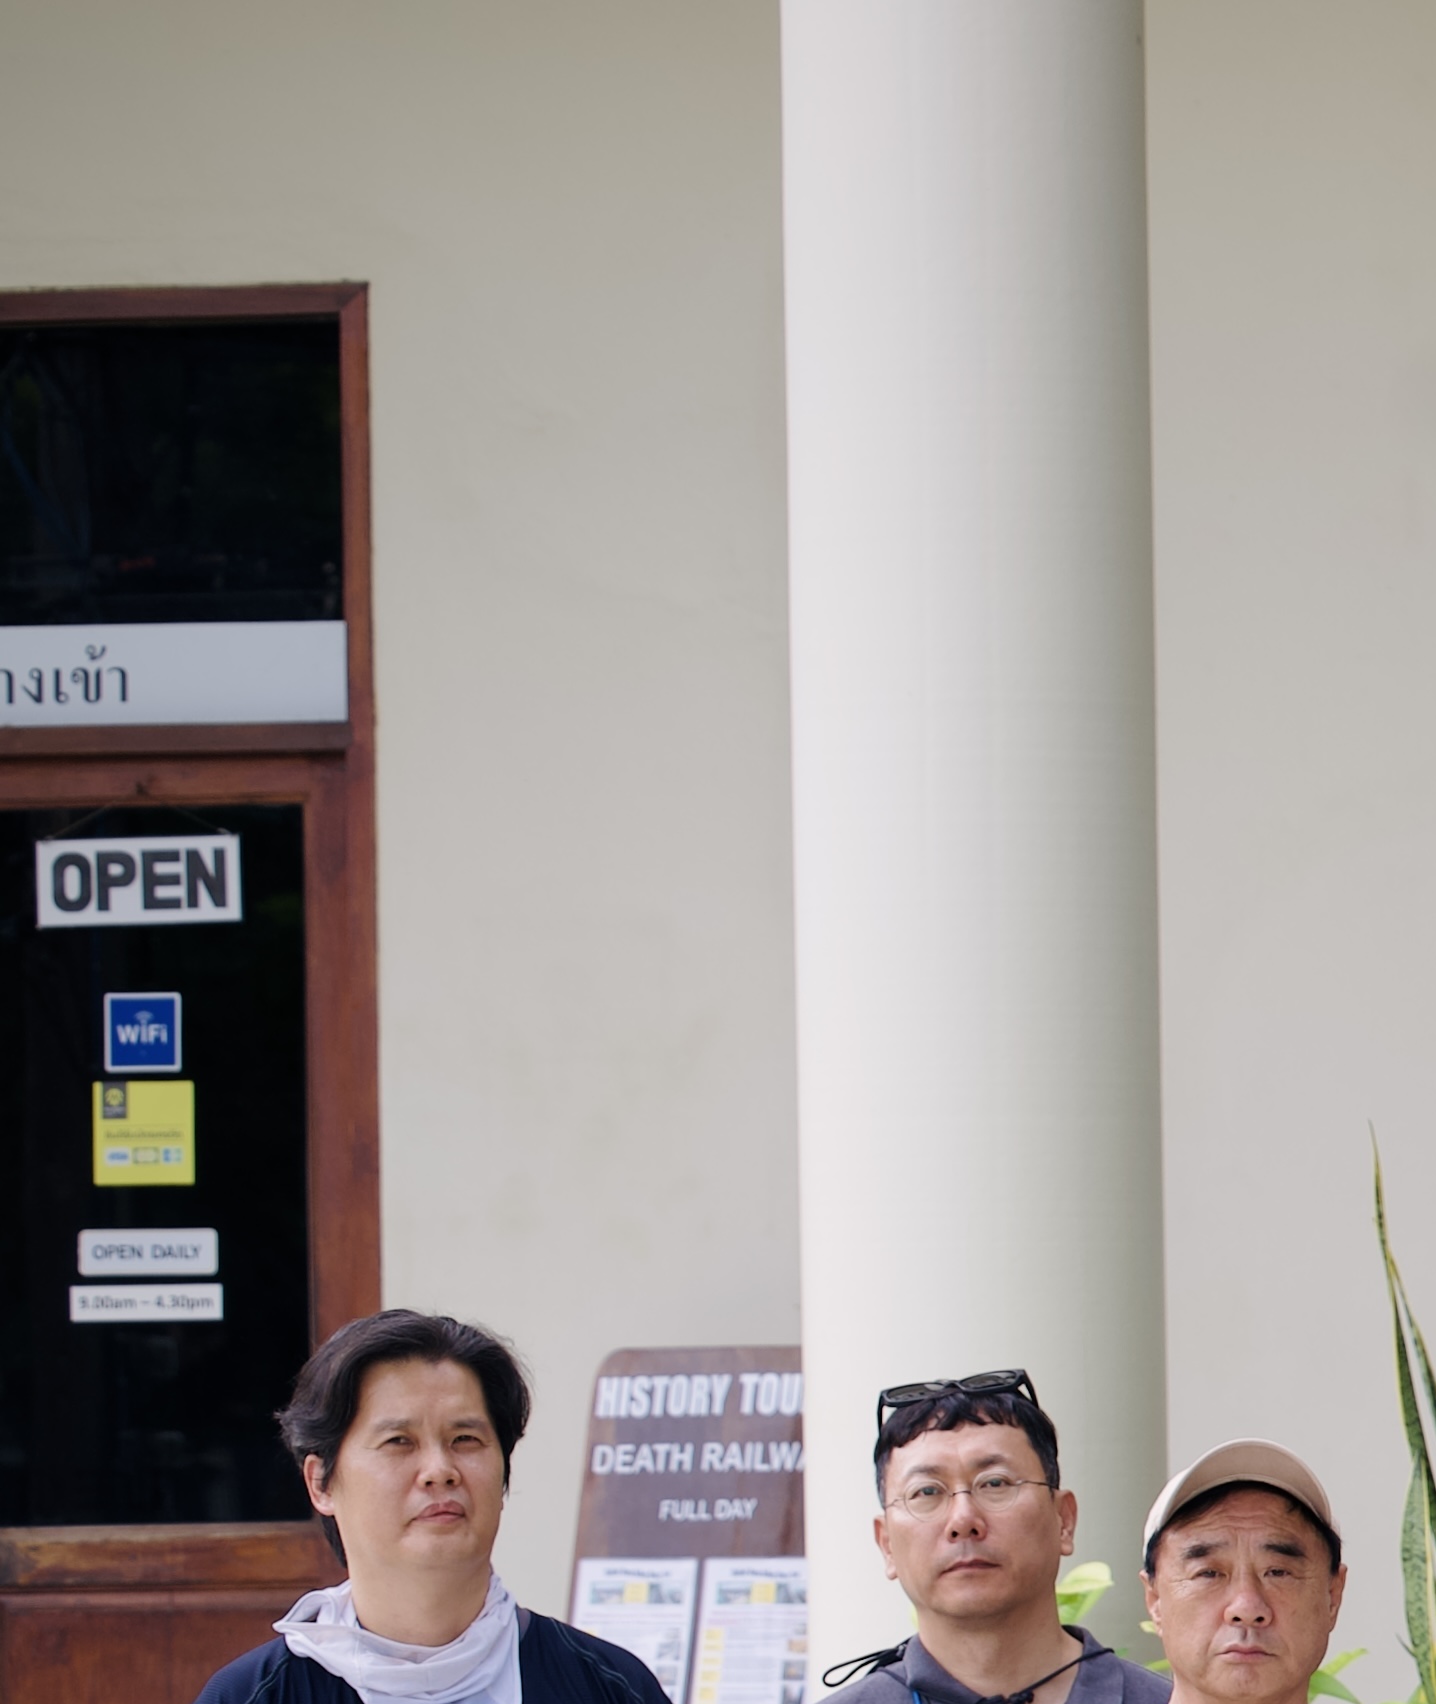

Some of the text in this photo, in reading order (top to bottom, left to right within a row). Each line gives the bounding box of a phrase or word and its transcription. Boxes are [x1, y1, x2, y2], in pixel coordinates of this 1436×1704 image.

[52, 846, 228, 912] OPEN
[91, 1244, 202, 1260] OPEN DAILY
[594, 1373, 733, 1419] HISTORY
[591, 1442, 695, 1475] DEATH
[657, 1498, 759, 1522] FULL DAY
